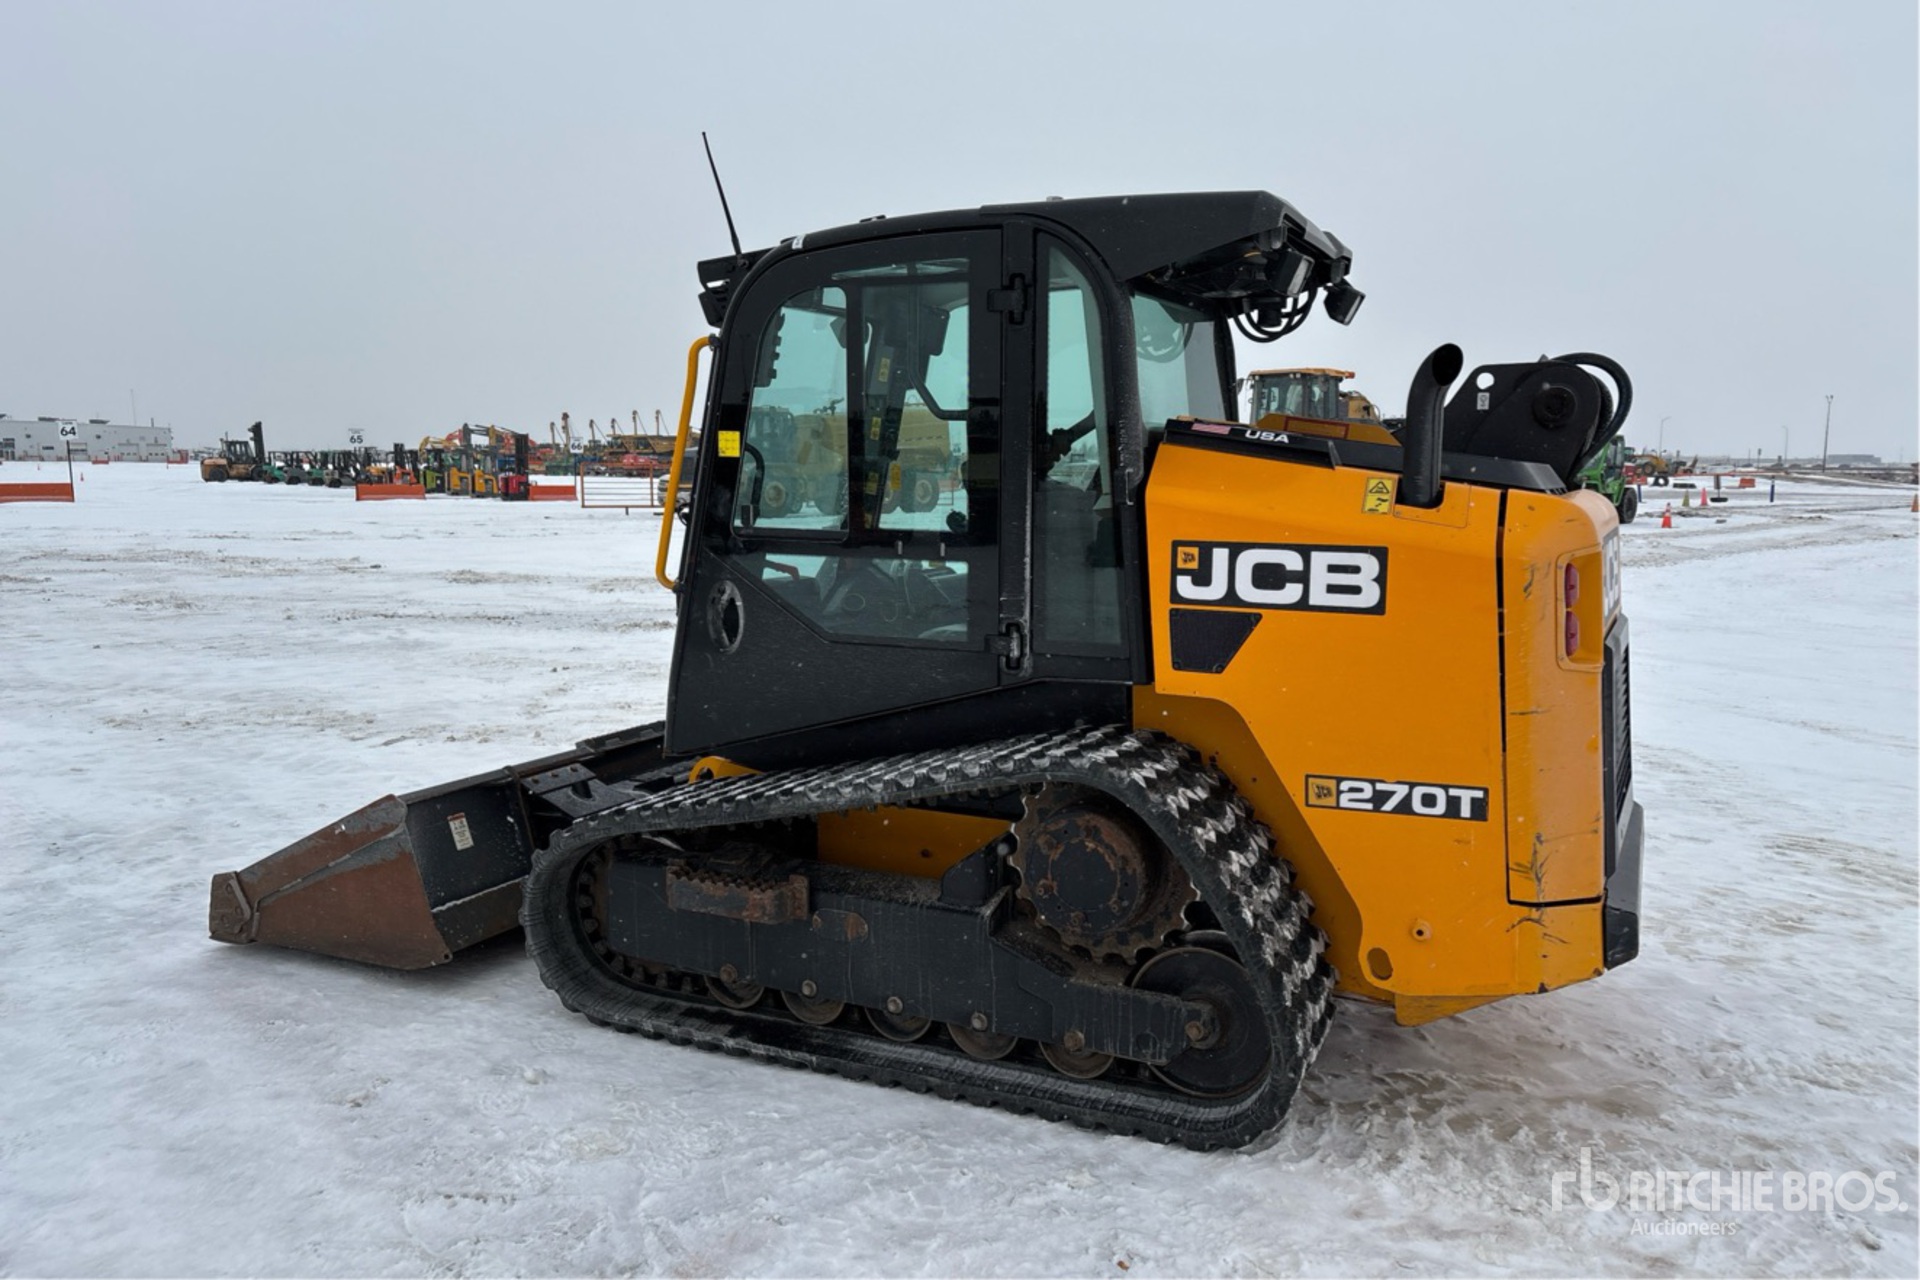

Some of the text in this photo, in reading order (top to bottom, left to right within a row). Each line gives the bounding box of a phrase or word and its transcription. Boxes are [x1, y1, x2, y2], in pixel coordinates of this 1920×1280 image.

[60, 426, 76, 436] 64
[1245, 429, 1290, 444] USA
[349, 434, 364, 444] 65
[571, 441, 583, 450] 66
[1176, 547, 1381, 608] JCB
[1339, 780, 1484, 818] 270T
